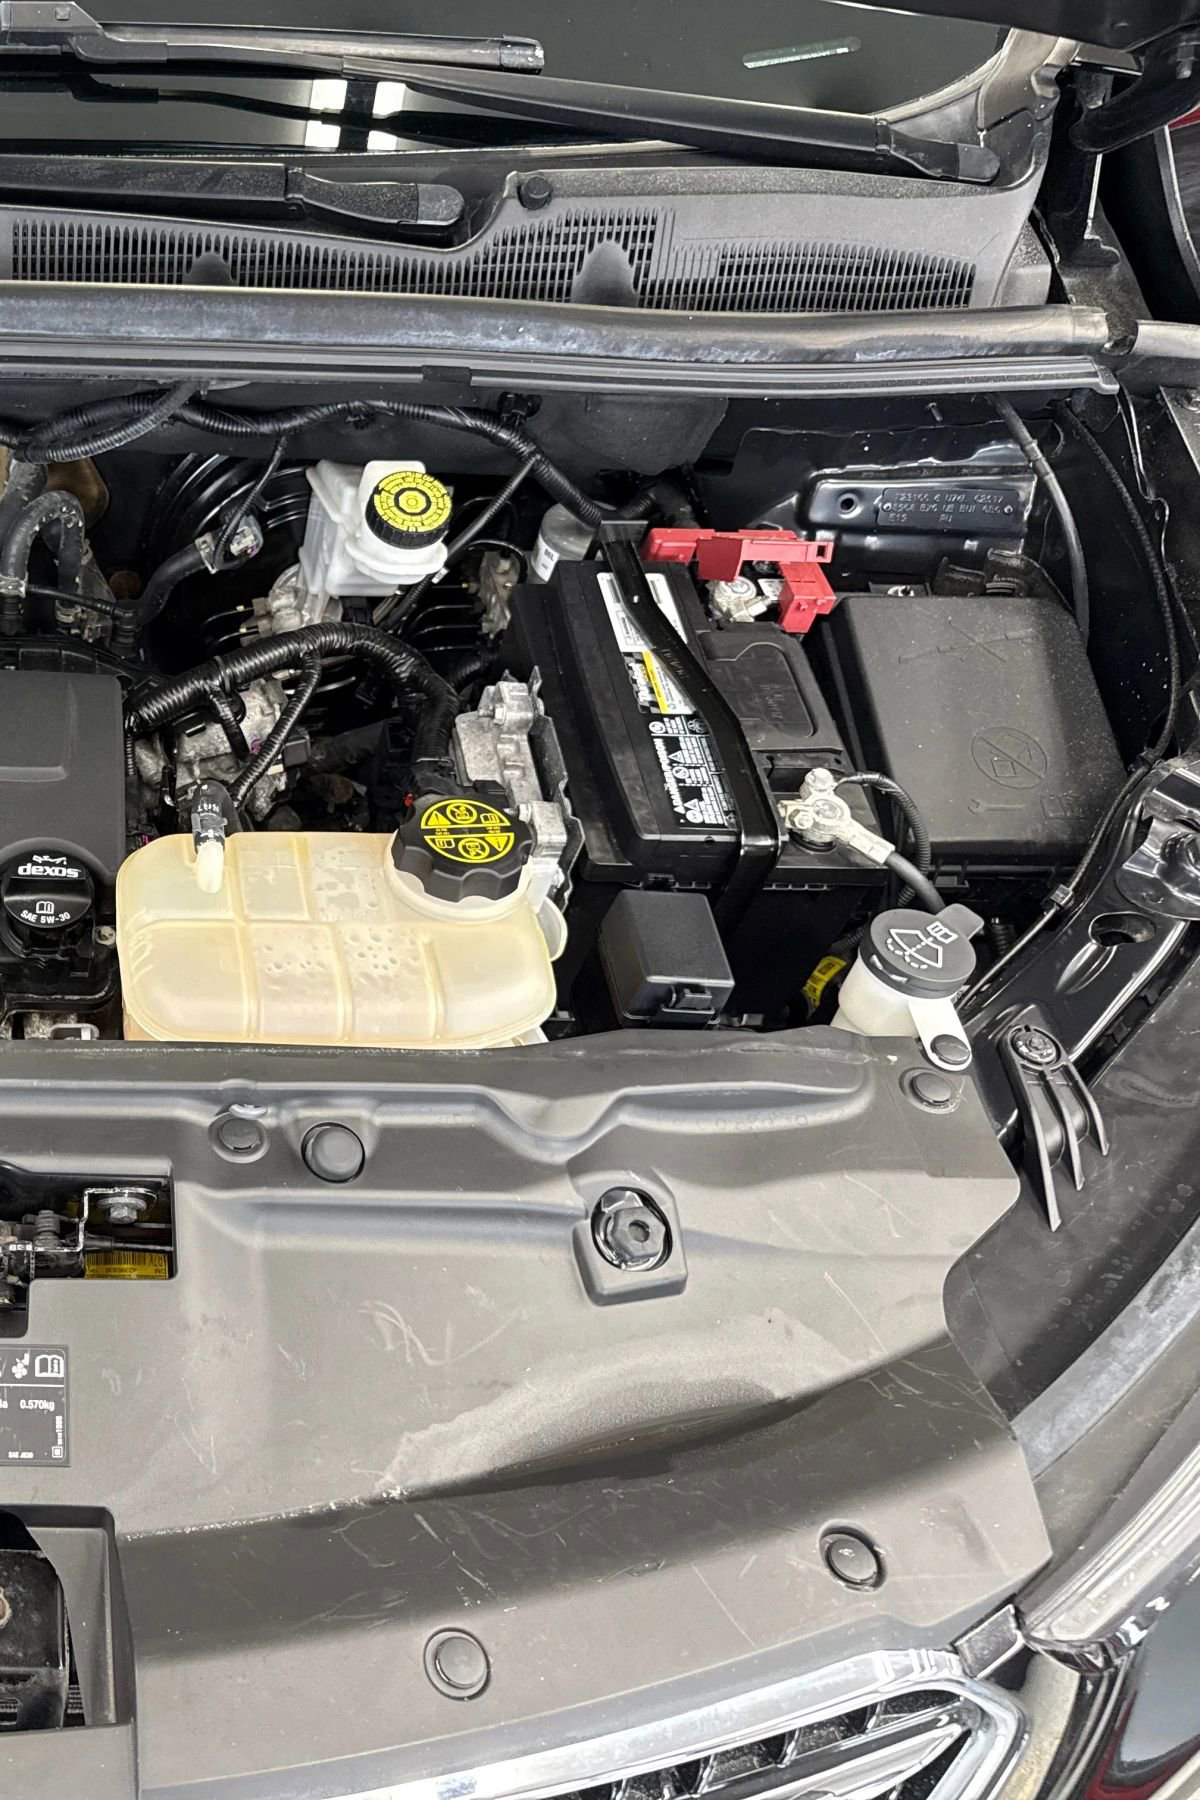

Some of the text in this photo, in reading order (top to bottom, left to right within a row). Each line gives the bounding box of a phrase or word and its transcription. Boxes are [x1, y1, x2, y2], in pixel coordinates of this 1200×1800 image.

[17, 863, 81, 878] dexos
[20, 910, 71, 923] SAE 5W-30
[20, 1399, 55, 1411] 0.570kg
